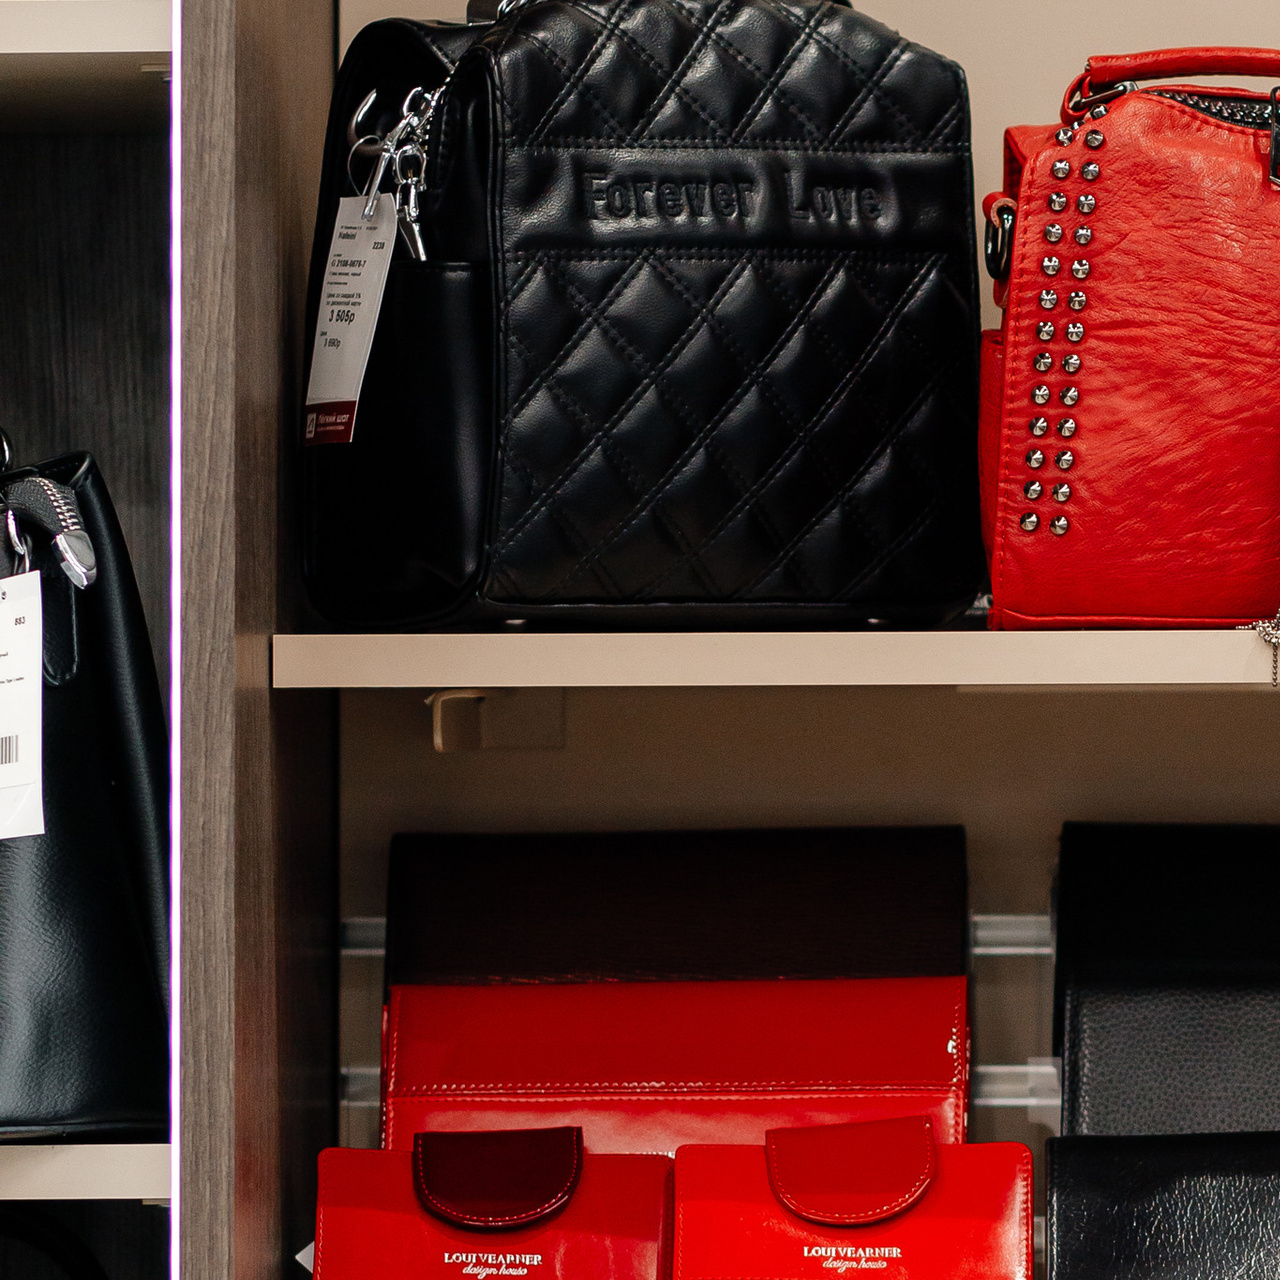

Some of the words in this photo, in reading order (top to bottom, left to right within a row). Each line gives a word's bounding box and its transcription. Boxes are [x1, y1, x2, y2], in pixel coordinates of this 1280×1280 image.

[584, 172, 755, 220] Forever
[785, 171, 882, 220] Love
[463, 1263, 498, 1280] design
[823, 1257, 858, 1273] design
